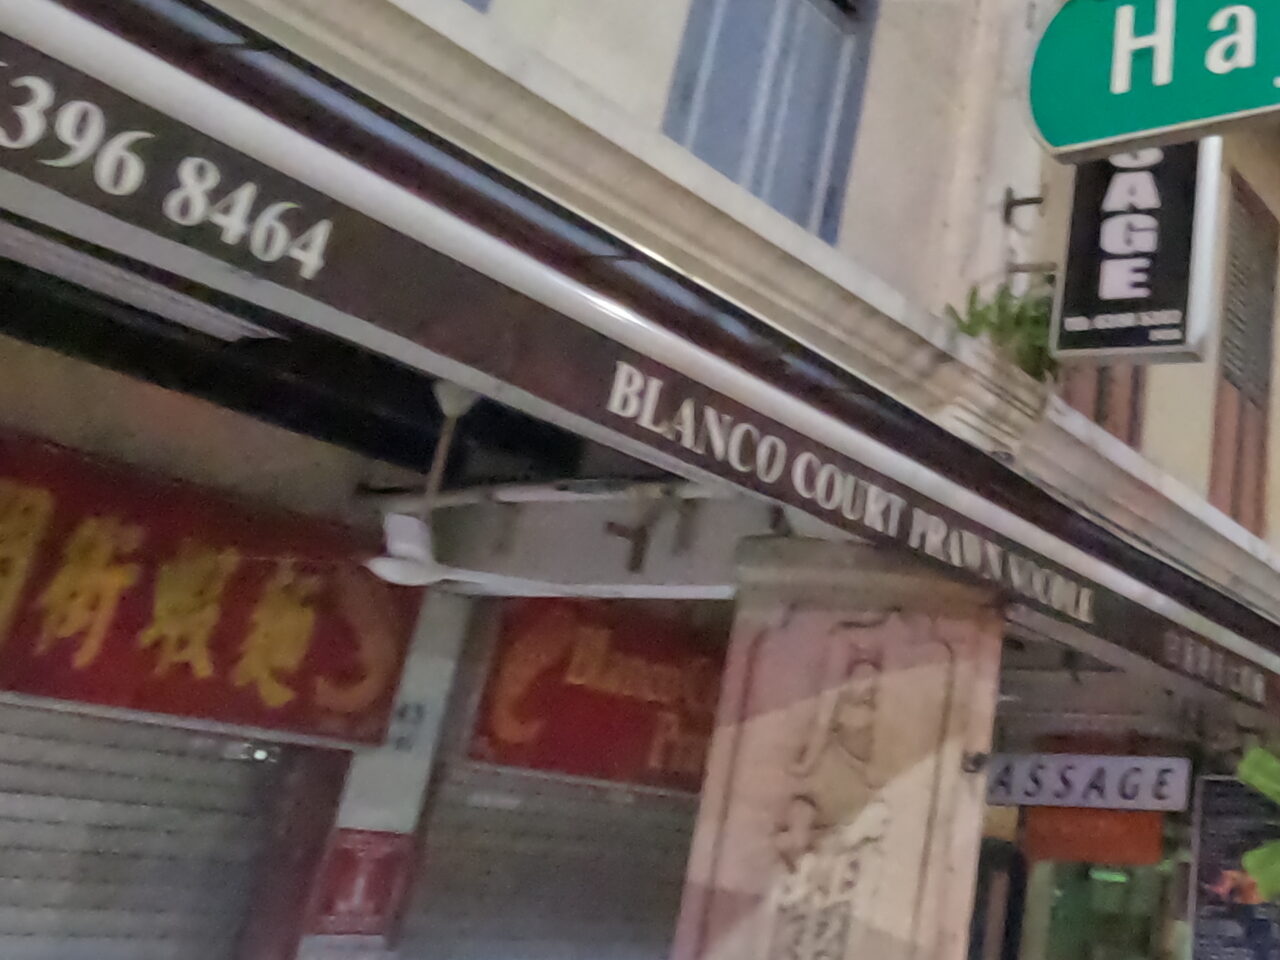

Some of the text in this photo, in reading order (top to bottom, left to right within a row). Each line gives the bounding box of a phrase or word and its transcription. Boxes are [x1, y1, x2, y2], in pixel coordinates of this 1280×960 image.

[0, 60, 334, 280] 396 8464
[607, 361, 787, 485] BLANCO
[791, 451, 907, 539] COURT
